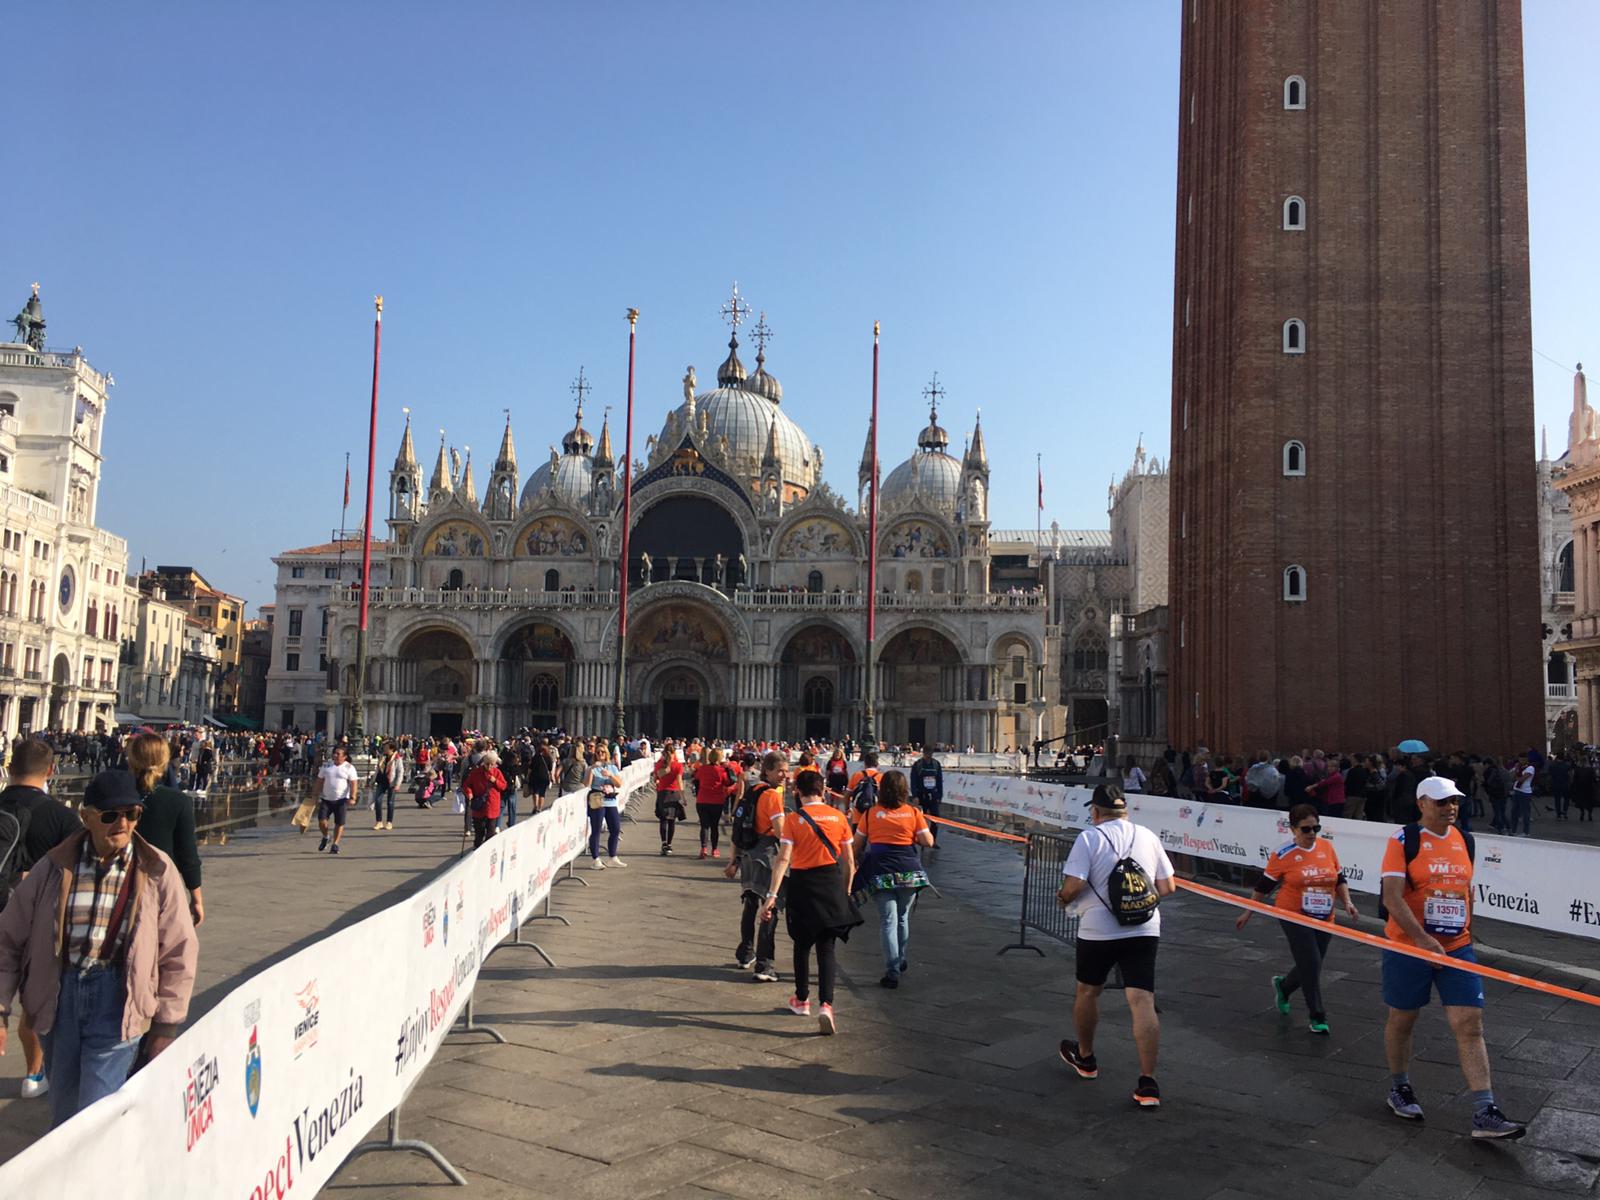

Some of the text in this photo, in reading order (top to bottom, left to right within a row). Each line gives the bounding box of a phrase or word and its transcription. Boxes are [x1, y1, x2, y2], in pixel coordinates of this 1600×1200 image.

[1159, 829, 1247, 857] #EnjoyRespectVenezia
[1436, 905, 1460, 917] 13570
[294, 1011, 319, 1040] VENICE
